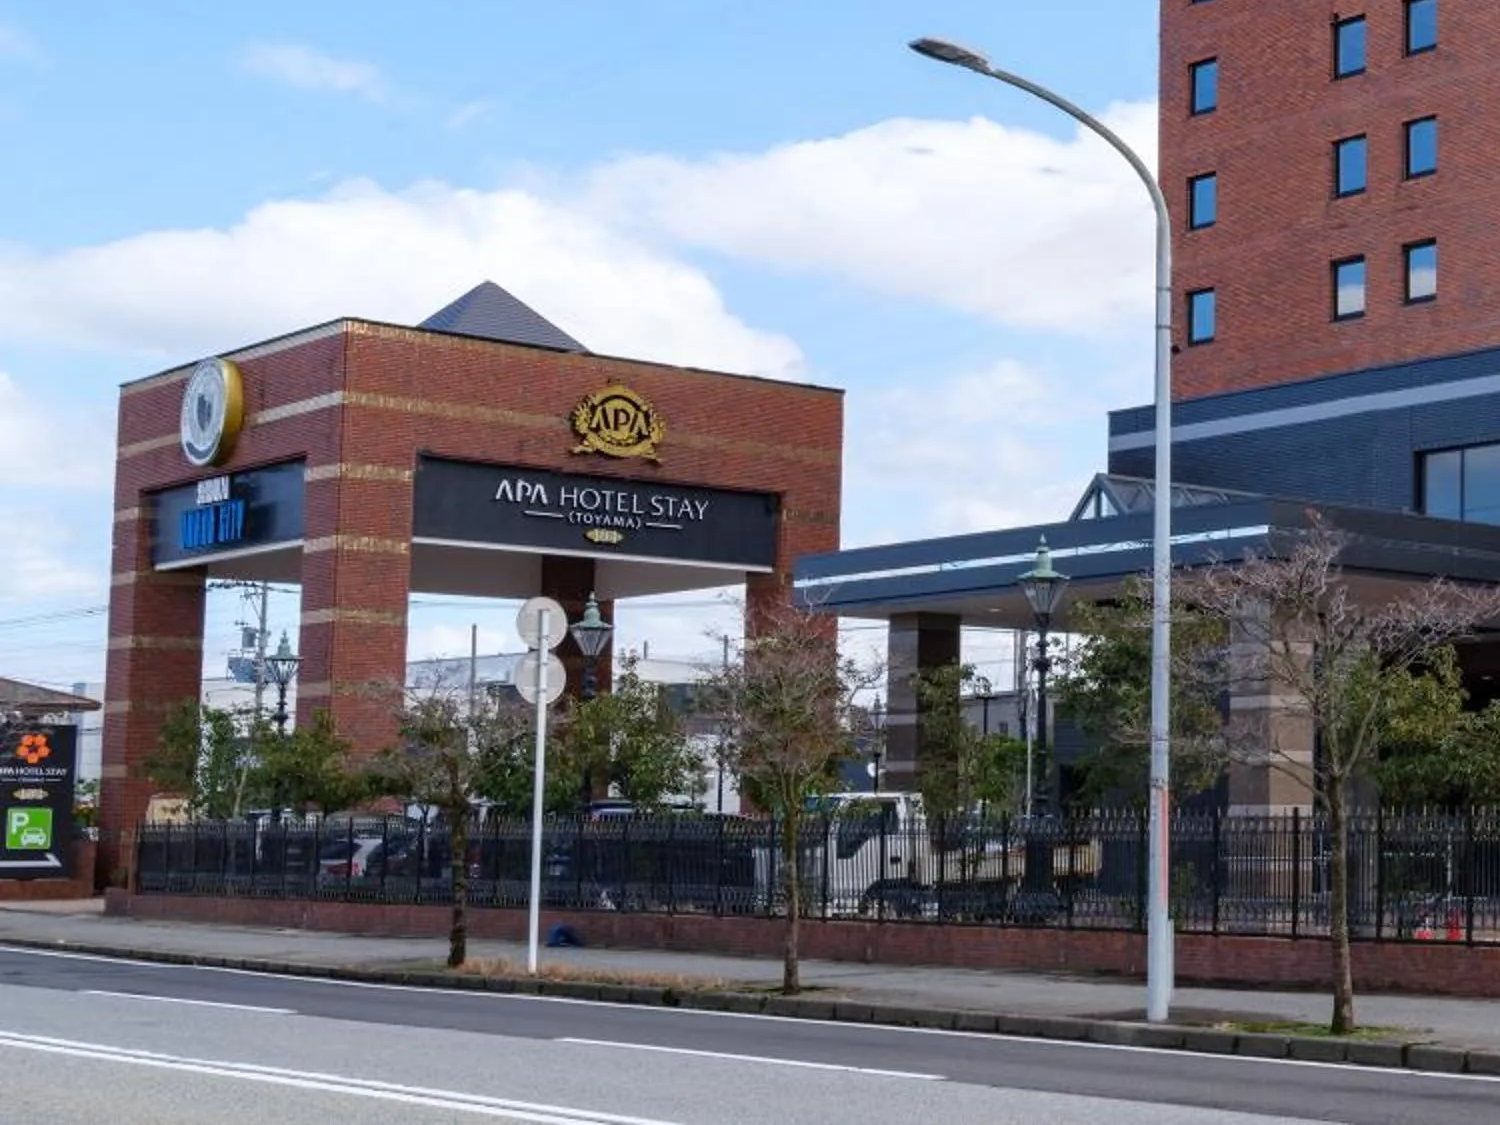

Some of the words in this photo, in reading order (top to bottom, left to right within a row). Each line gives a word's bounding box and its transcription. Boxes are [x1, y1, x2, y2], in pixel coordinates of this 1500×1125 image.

[589, 404, 650, 436] APA
[495, 478, 549, 504] APA
[560, 486, 645, 514] HOTEL
[651, 495, 709, 520] STAY
[11, 812, 29, 835] P
